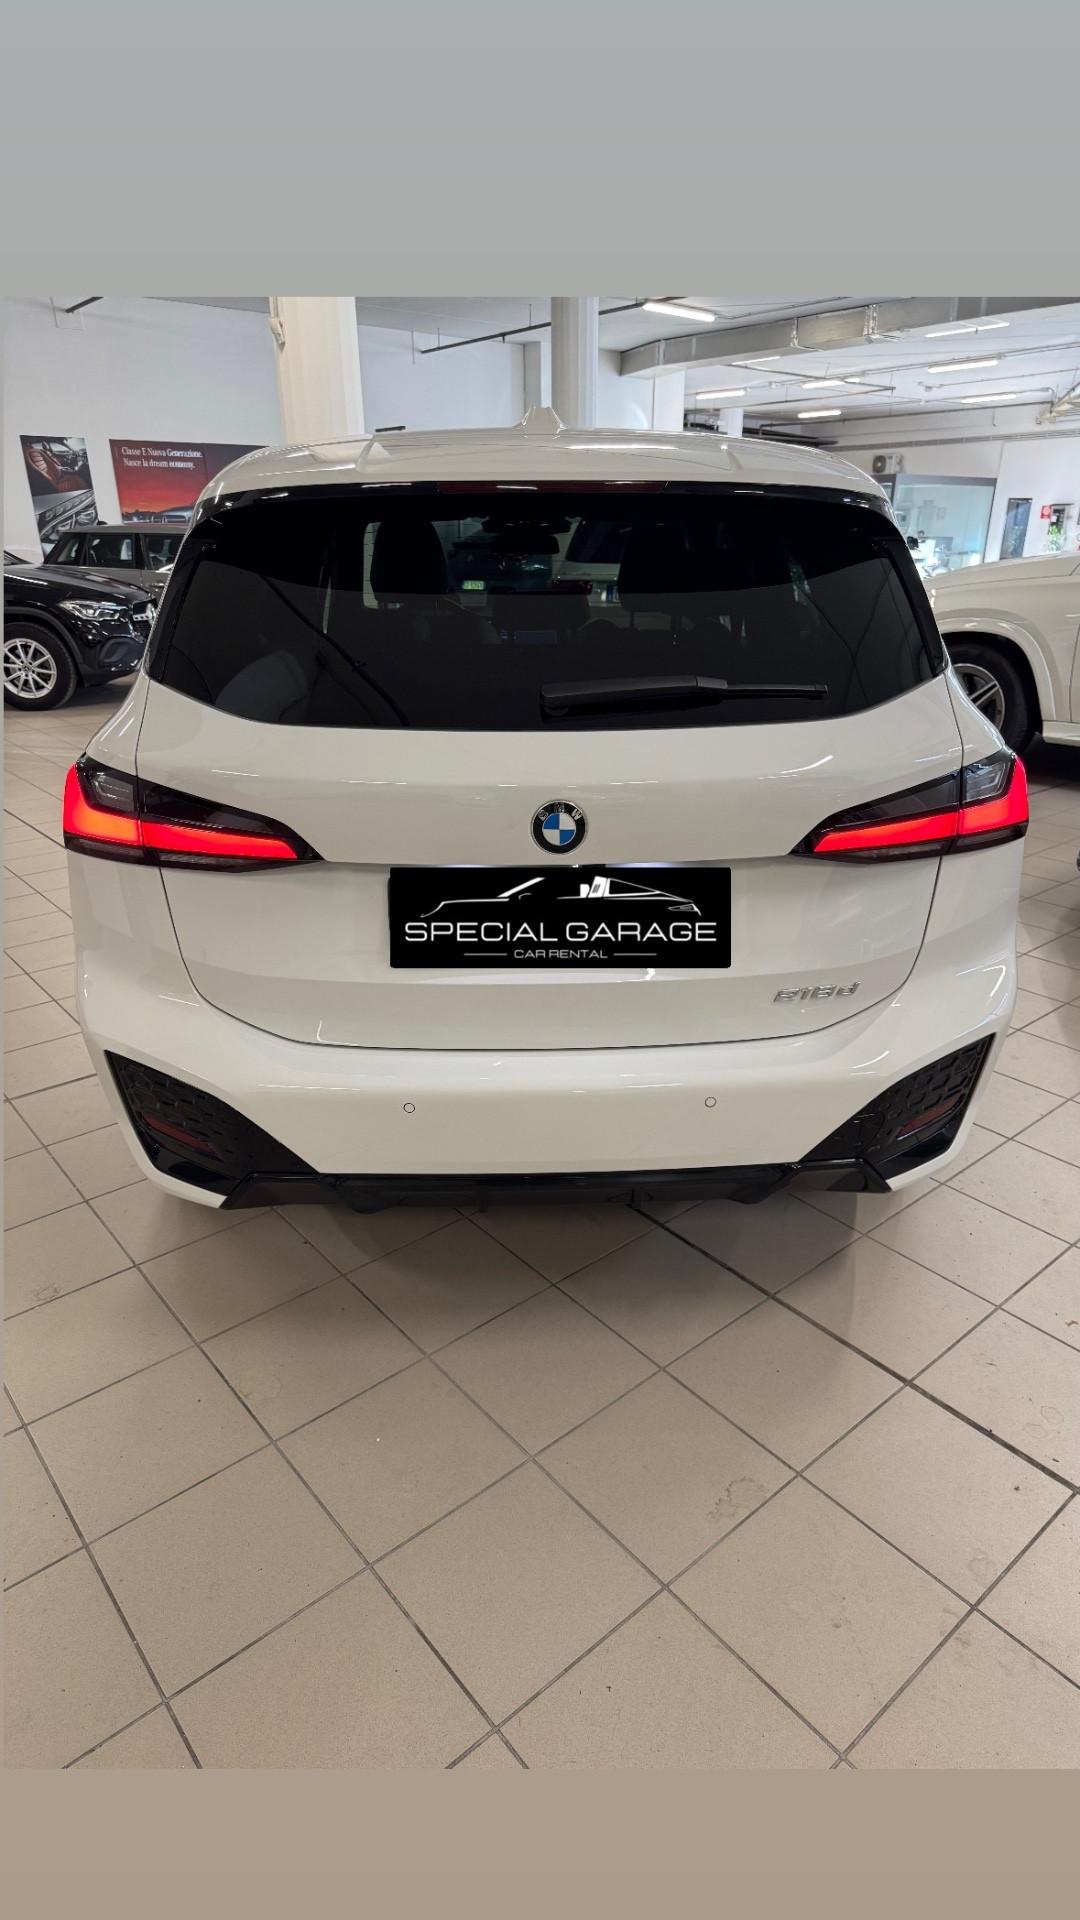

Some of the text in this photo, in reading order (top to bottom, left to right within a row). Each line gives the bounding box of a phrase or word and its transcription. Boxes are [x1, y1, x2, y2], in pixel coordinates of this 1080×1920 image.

[121, 446, 141, 456] Classe
[141, 447, 147, 456] E
[147, 447, 166, 457] Nuova
[123, 458, 141, 467] Nasce
[142, 459, 149, 467] la
[150, 459, 168, 468] dream
[537, 802, 582, 821] BMW
[773, 981, 861, 1002] 218d
